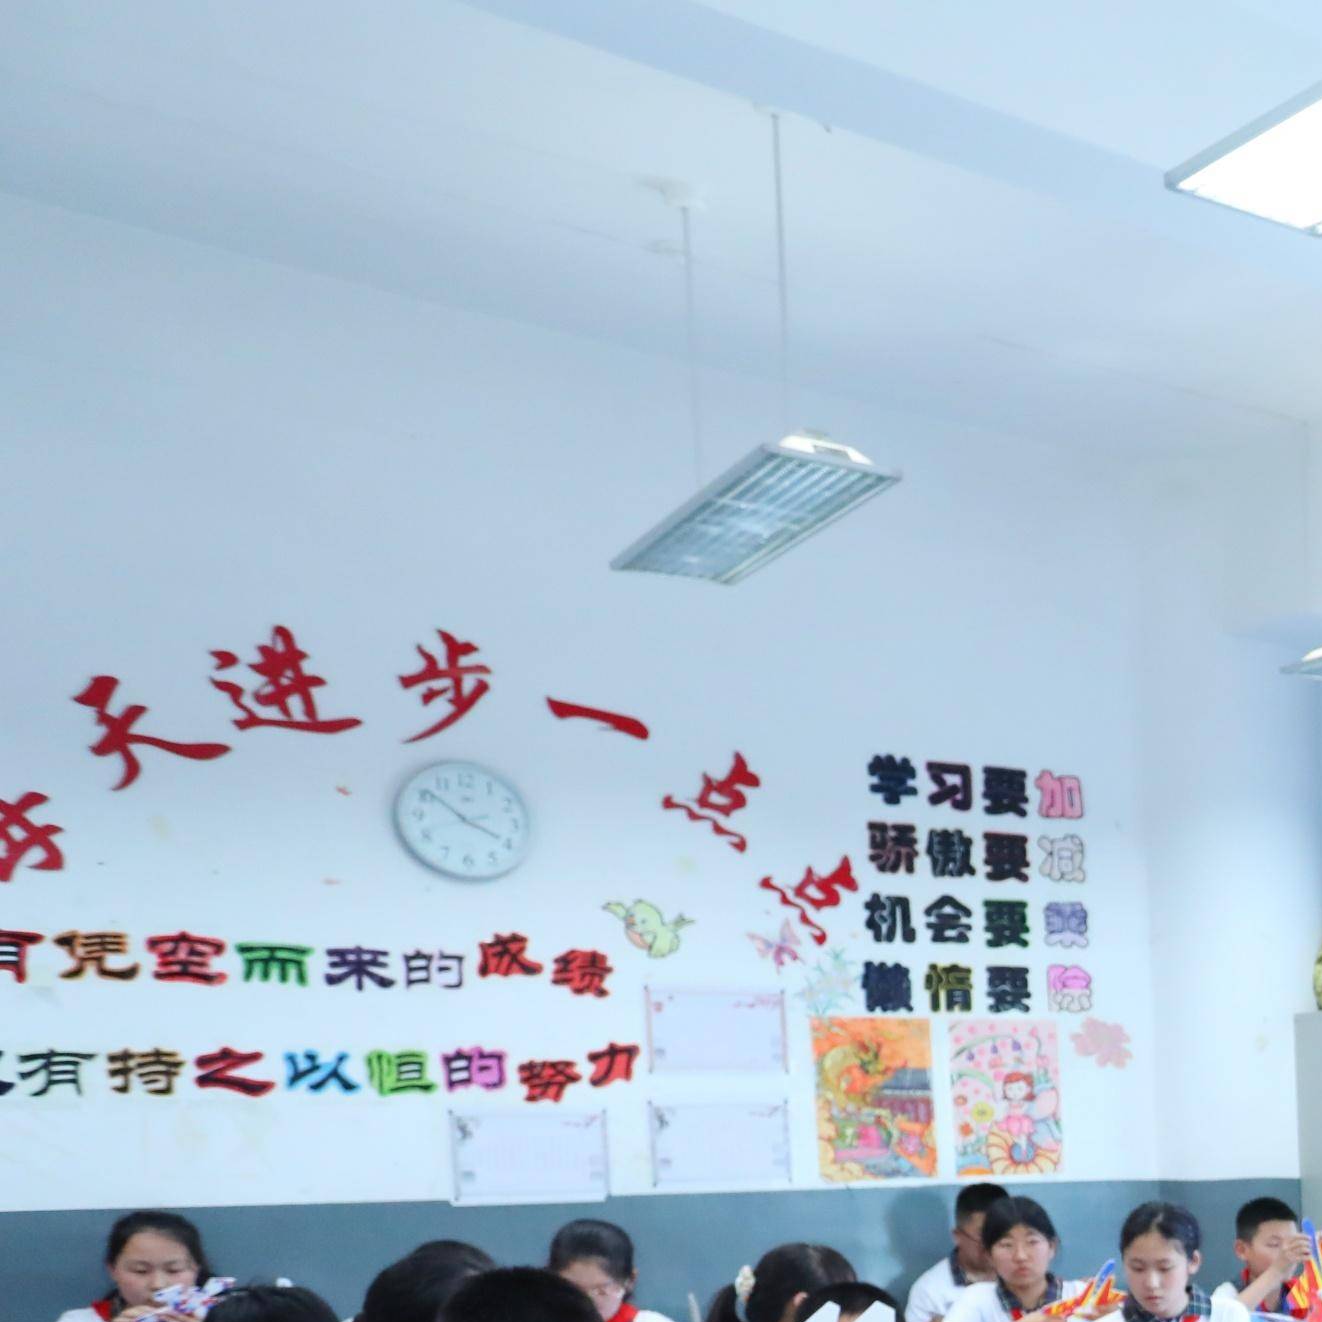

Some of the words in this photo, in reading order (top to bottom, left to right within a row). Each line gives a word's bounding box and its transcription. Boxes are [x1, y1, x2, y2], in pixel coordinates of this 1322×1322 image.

[867, 754, 1084, 819] 学习要加
[867, 821, 1087, 883] 骄傲要减
[864, 893, 1089, 949] 机会要乘
[861, 960, 1092, 1014] 懒惰要除
[0, 1042, 640, 1103] 有持之以恒的努力
